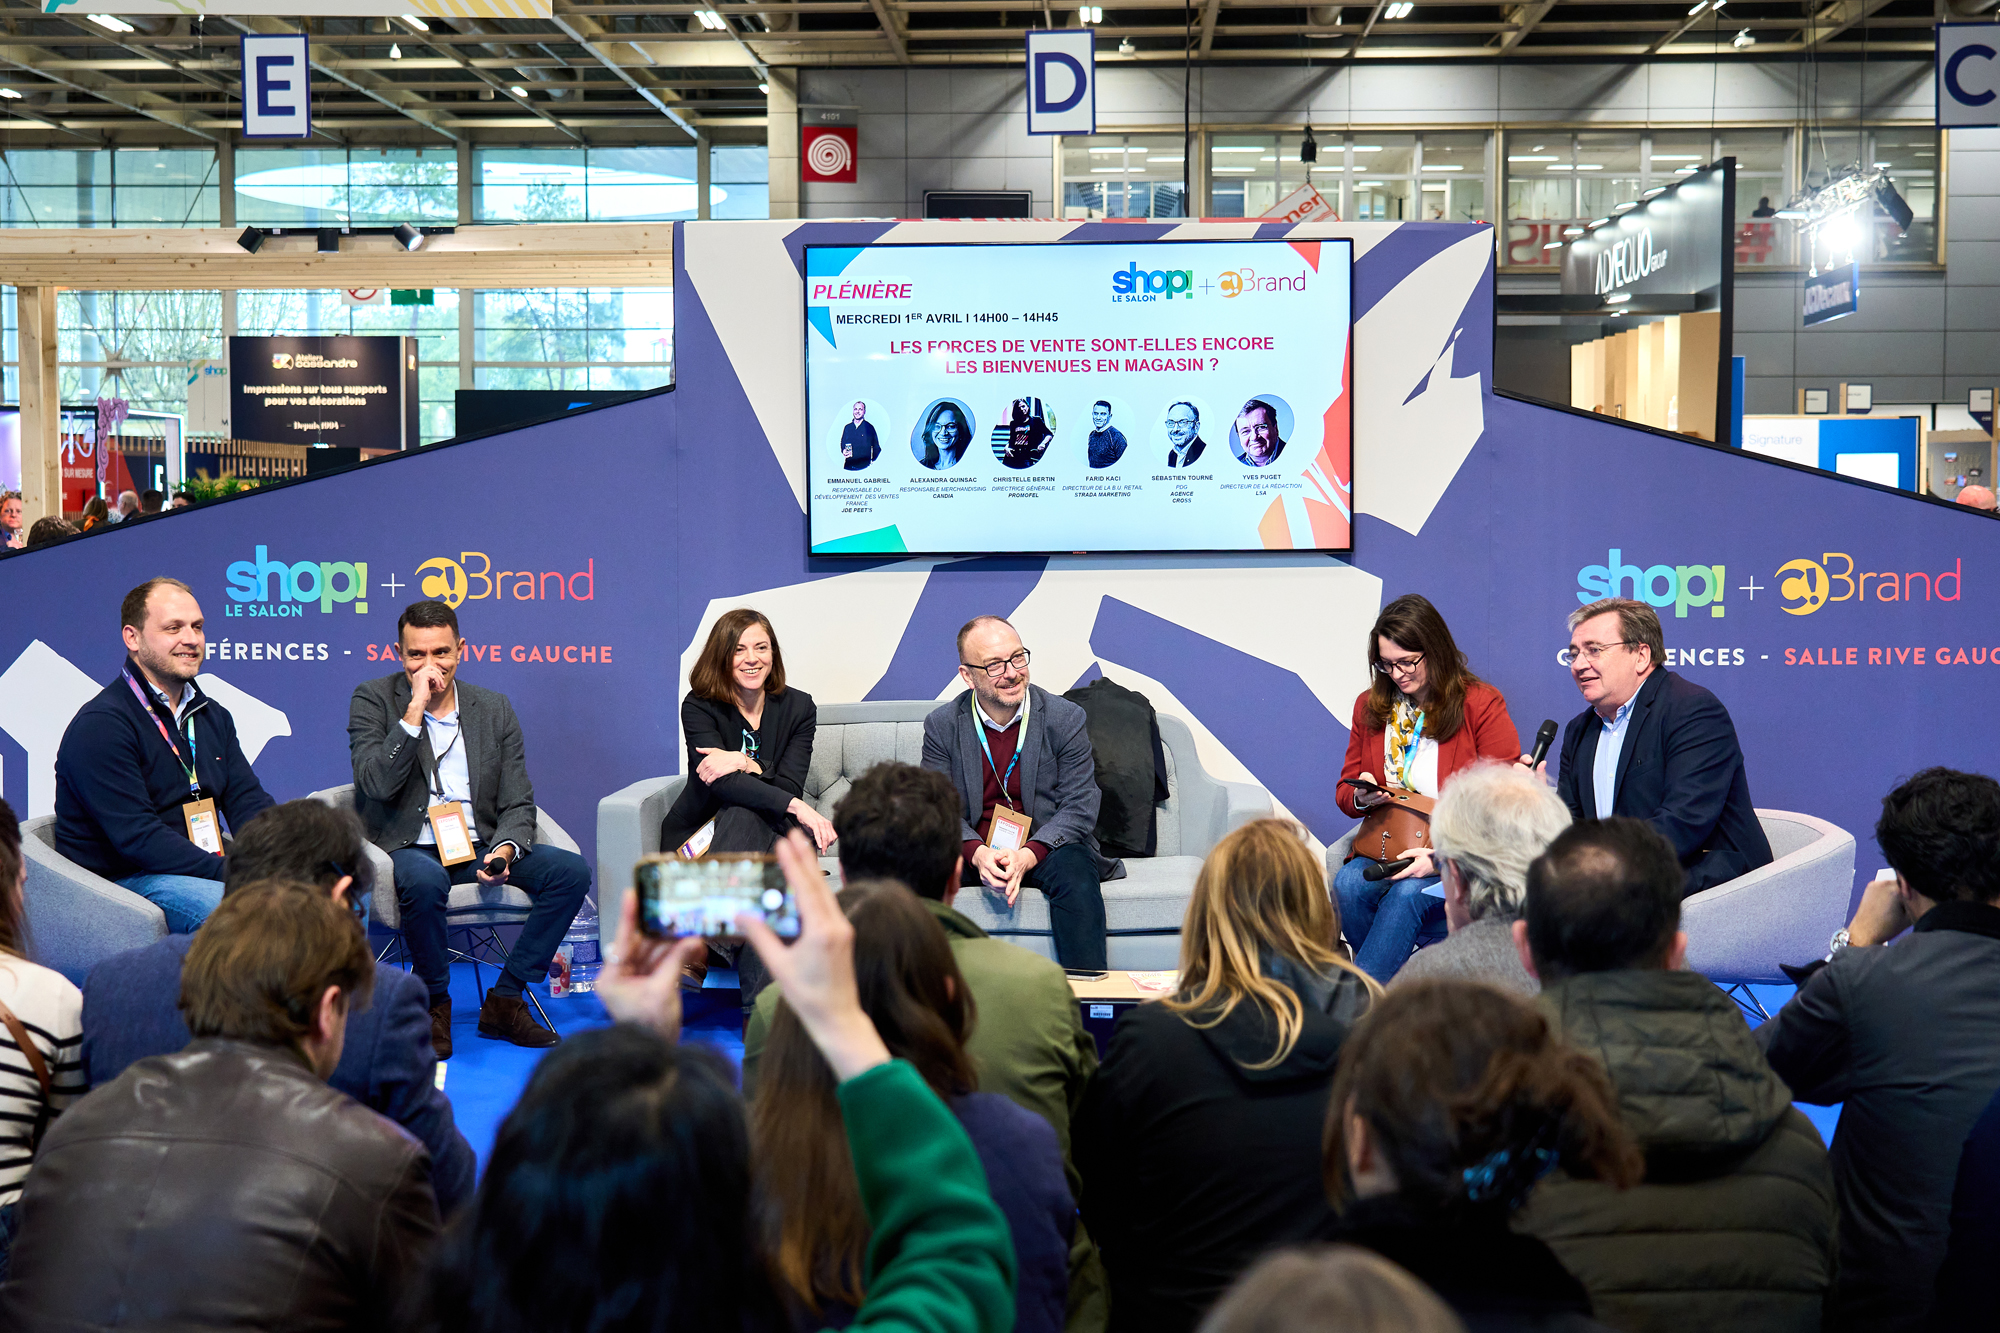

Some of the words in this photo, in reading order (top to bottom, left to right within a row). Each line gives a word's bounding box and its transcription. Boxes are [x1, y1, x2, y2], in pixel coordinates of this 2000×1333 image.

[1034, 52, 1087, 114] D
[1944, 44, 1997, 107] C
[256, 56, 296, 117] E
[1112, 261, 1193, 299] shop!
[813, 280, 913, 300] PLÉNIÈRE
[1112, 295, 1122, 303] LE
[1126, 294, 1156, 303] SALON
[836, 314, 901, 324] MERCREDI
[926, 313, 962, 324] AVRIL
[973, 313, 1009, 323] 14H00
[1022, 312, 1059, 323] 14H45
[890, 340, 923, 354] LES
[927, 339, 997, 354] FORCES
[1002, 339, 1025, 353] DE
[1030, 338, 1086, 353] VENTE
[1091, 337, 1197, 352] SONT-ELLES
[1202, 336, 1275, 351] ENCORE
[295, 358, 358, 369] cassandre
[946, 360, 978, 374] LES
[983, 359, 1092, 374] BIENVENUES
[1097, 359, 1119, 373] EN
[1125, 358, 1204, 372] MAGASIN
[243, 384, 302, 396] Impressions
[303, 386, 320, 394] sur
[320, 385, 343, 395] tous
[343, 384, 388, 396] supports
[264, 397, 288, 407] pour
[289, 398, 308, 406] vos
[309, 395, 367, 406] décorations
[1748, 434, 1803, 447] Signature
[225, 544, 368, 614] shop!
[1576, 548, 1726, 618] shop!
[225, 604, 244, 618] LE
[248, 604, 303, 618] SALON
[205, 637, 330, 661] FÉRENCES
[463, 645, 502, 663] IVE
[510, 645, 613, 664] GAUCHE
[1784, 648, 1864, 666] SALLE
[1868, 647, 1926, 665] RIVE
[1935, 647, 2000, 665] GAUC
